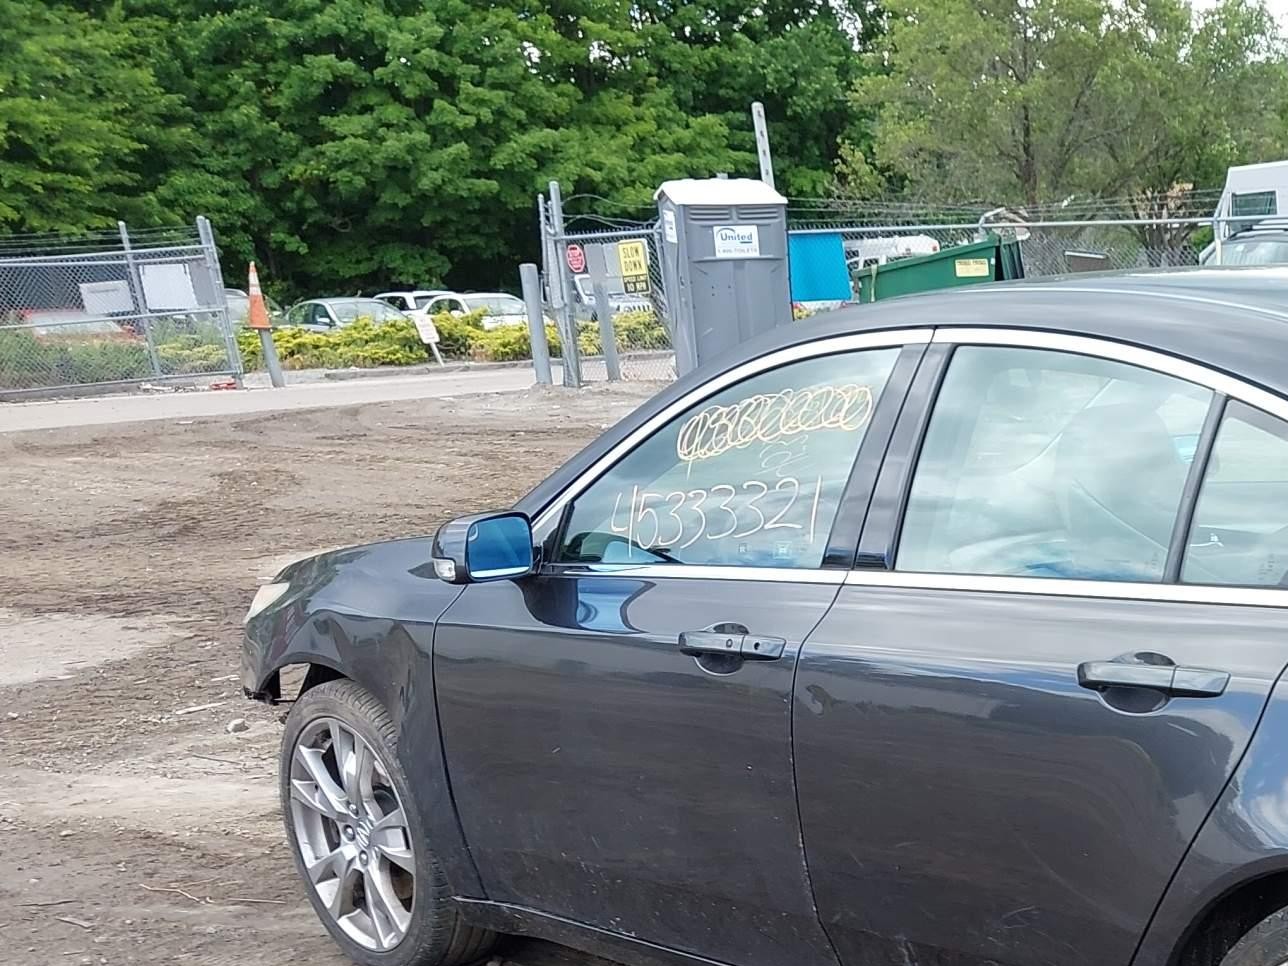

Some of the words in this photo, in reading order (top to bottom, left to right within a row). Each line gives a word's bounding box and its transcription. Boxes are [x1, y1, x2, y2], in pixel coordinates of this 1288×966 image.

[720, 232, 753, 241] United
[622, 246, 640, 259] SLOW
[624, 260, 643, 272] DOWN
[611, 474, 823, 559] 45333321
